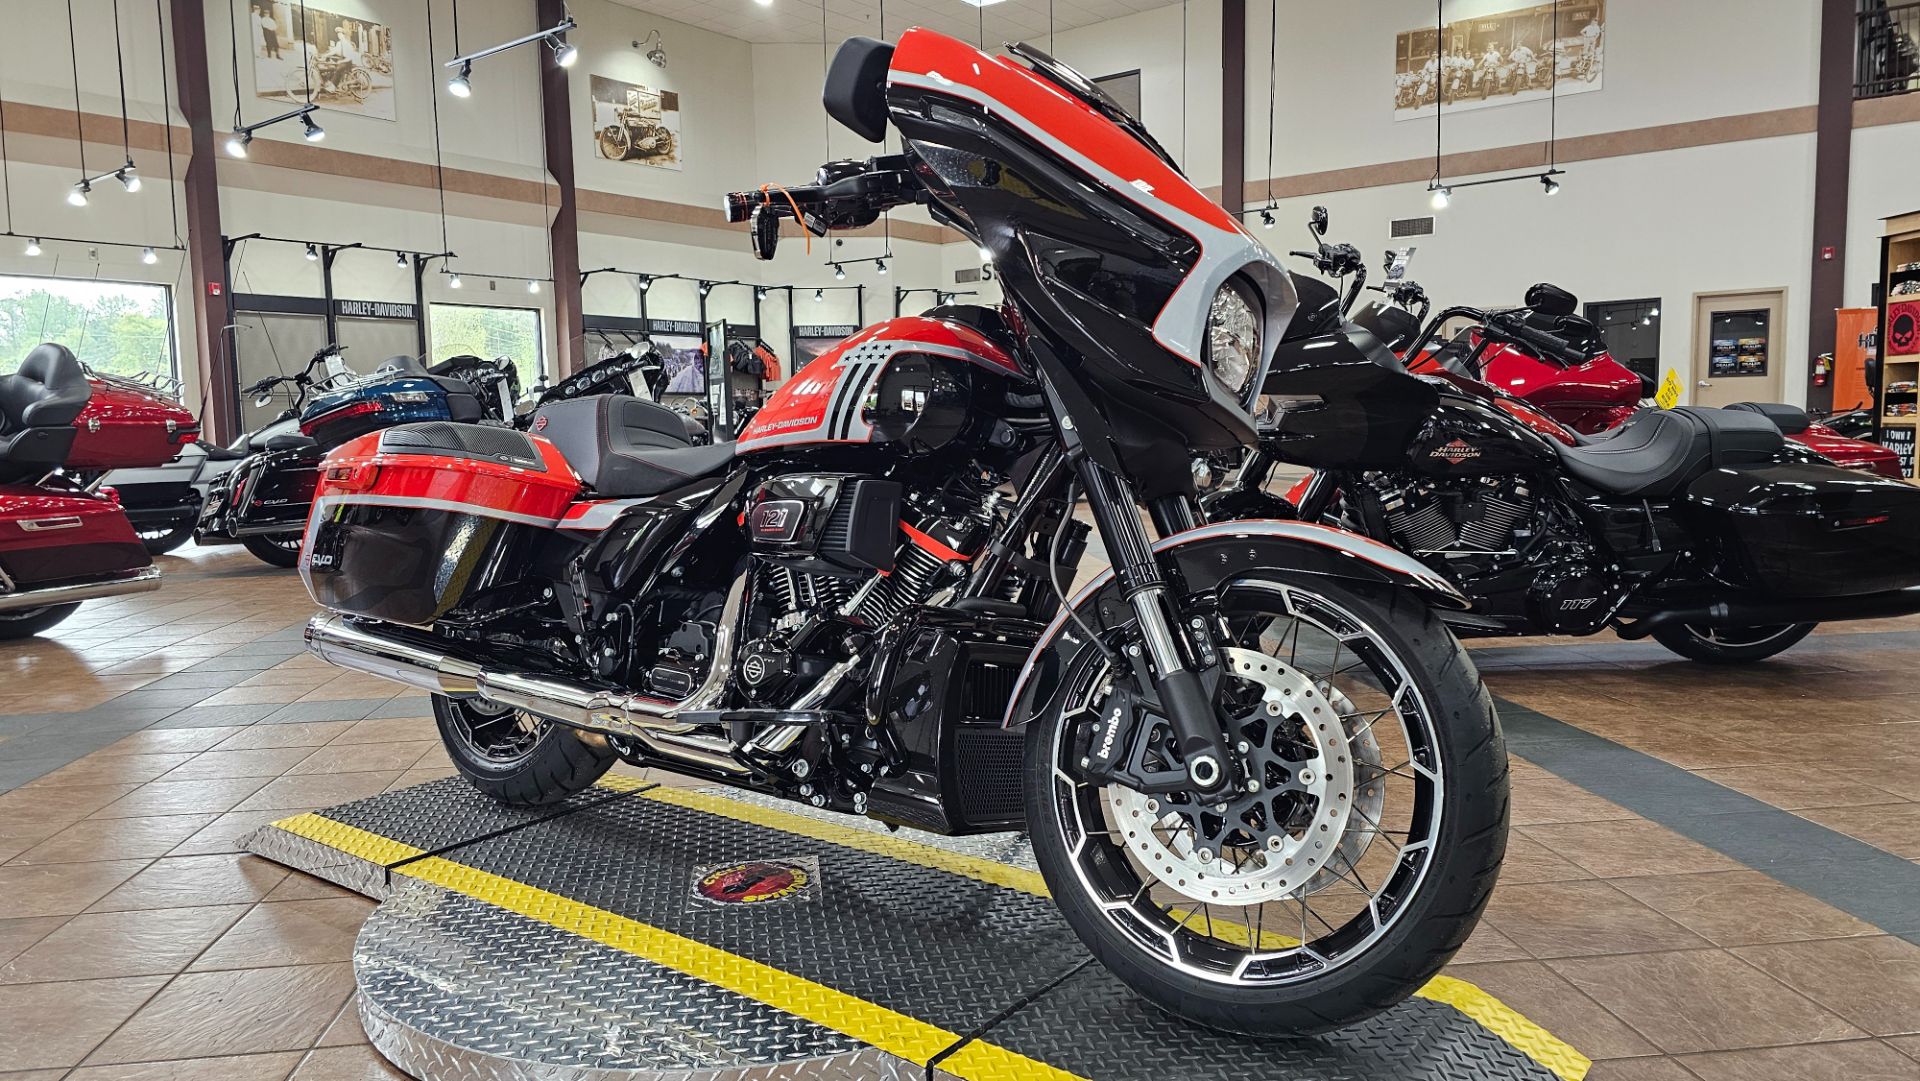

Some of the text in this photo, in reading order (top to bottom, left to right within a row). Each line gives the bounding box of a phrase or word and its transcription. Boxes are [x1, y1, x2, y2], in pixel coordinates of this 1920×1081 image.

[341, 300, 413, 318] HARLEY-DAVIDSON
[652, 319, 700, 333] HARLEY-DAVIDSON
[752, 416, 818, 434] HARLEY-DAVIDSON
[760, 508, 788, 527] 121
[1560, 597, 1598, 610] 117
[1096, 707, 1122, 760] brembo
